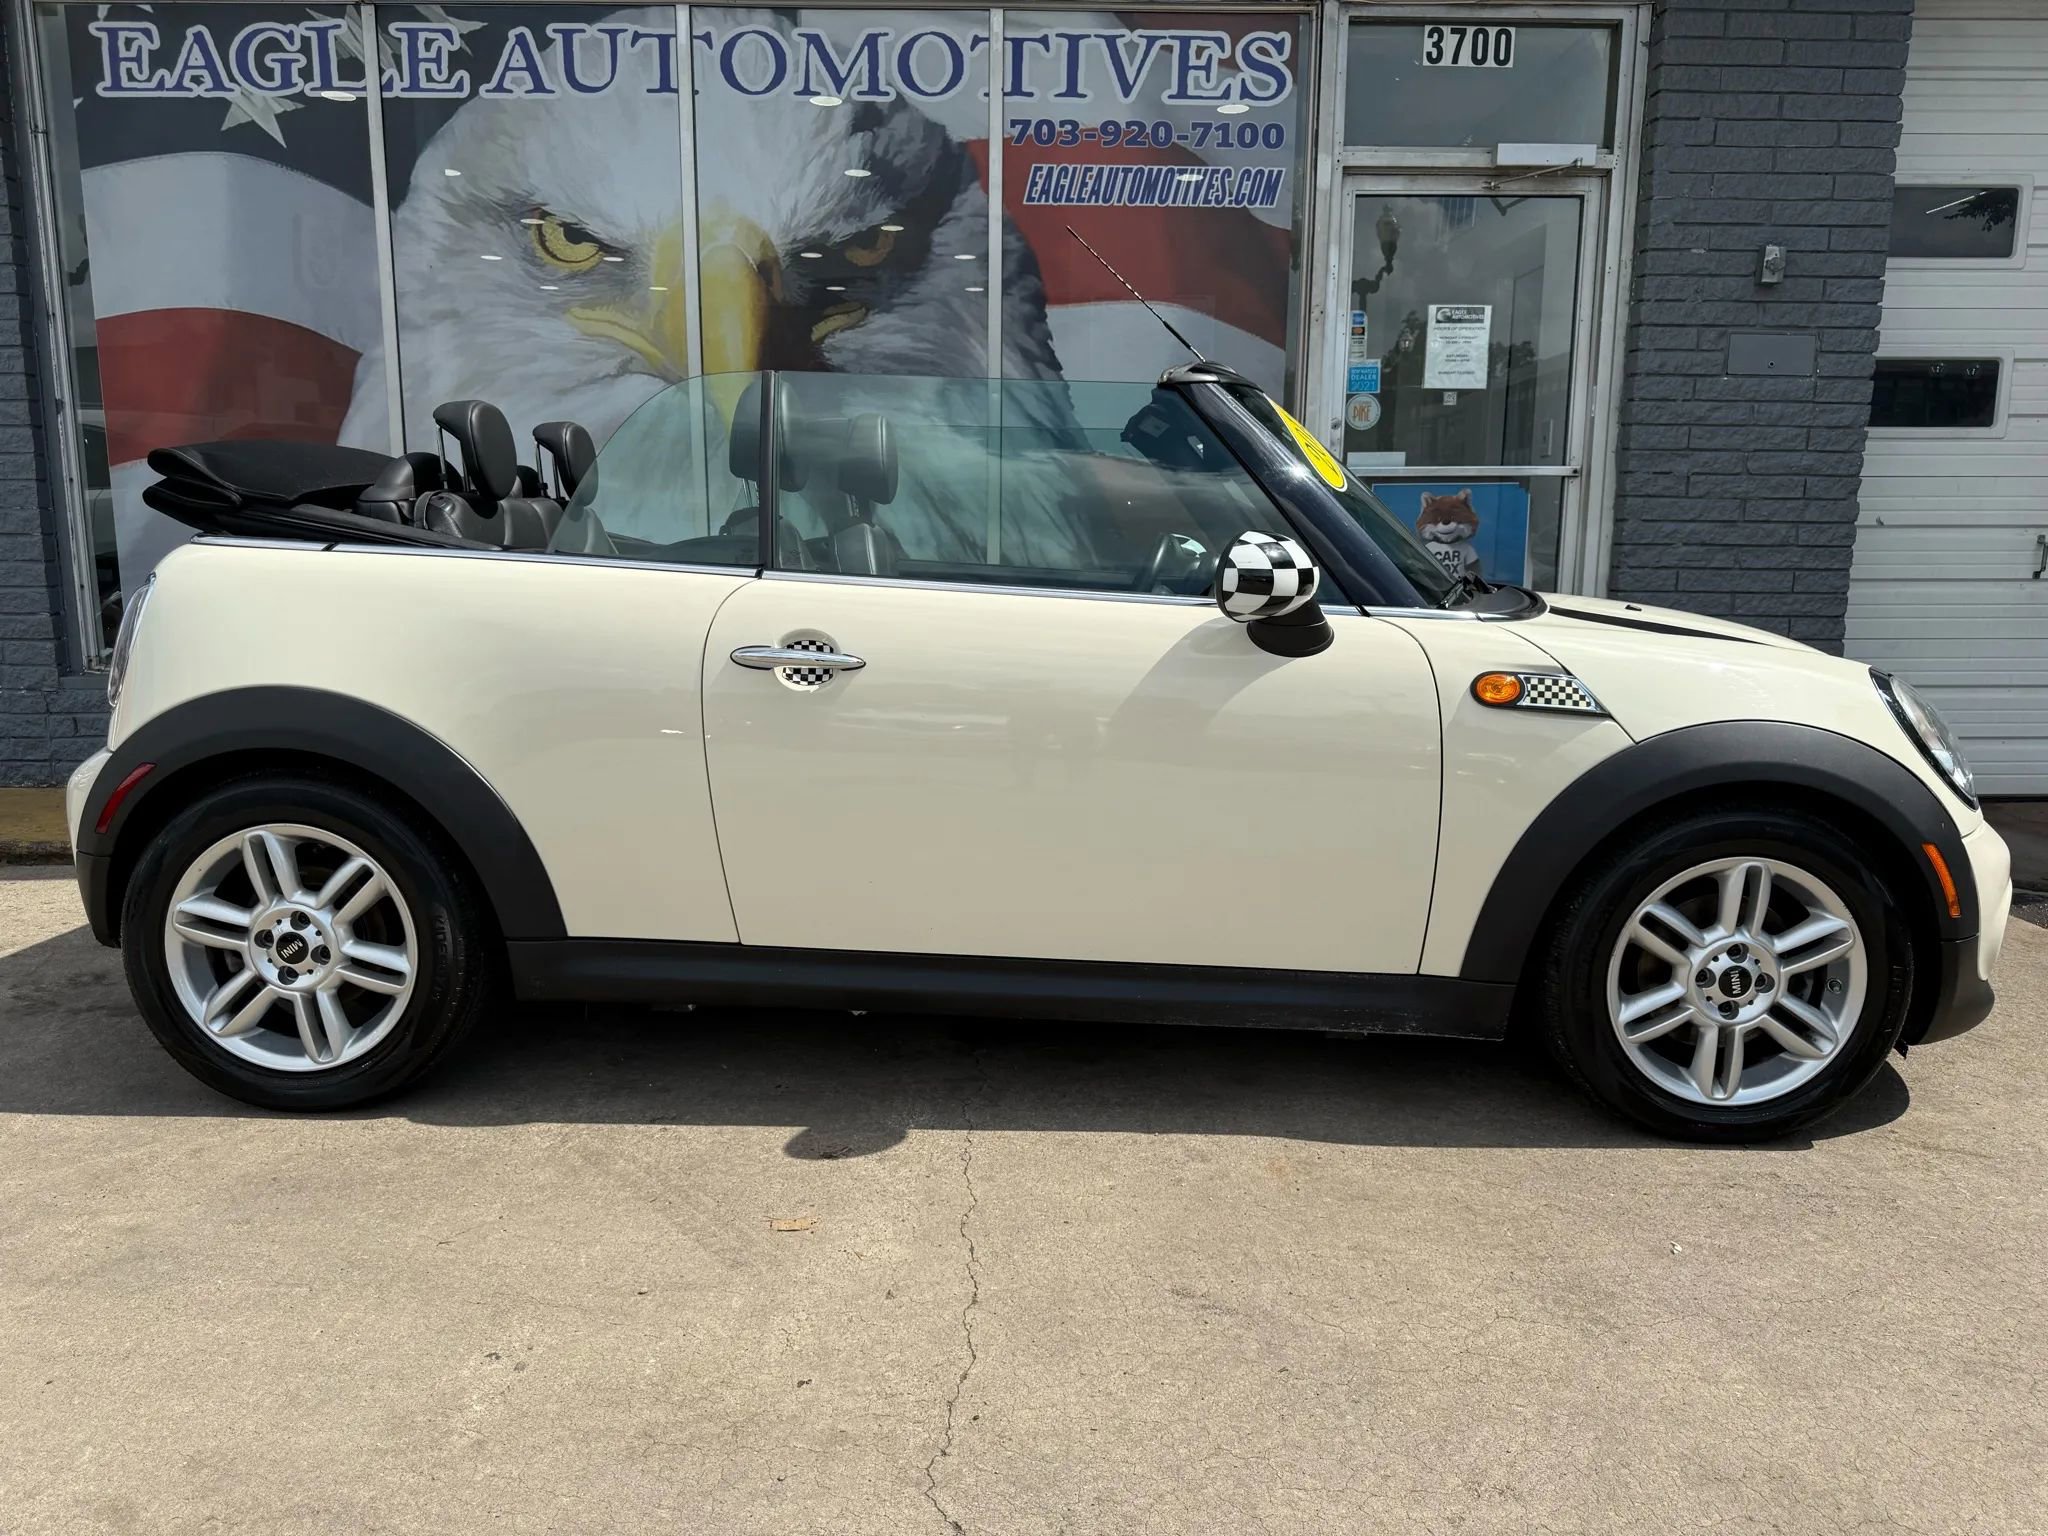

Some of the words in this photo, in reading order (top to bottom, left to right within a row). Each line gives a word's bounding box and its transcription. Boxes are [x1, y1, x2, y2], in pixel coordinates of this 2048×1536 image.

[1426, 26, 1512, 67] 3700
[90, 22, 471, 98] EAGLE
[481, 22, 1292, 106] AUTOMOTIVES
[1009, 118, 1285, 149] 703-920-7100
[1023, 164, 1286, 208] EAGLEAUTOMOTIVES.COM
[1434, 550, 1461, 562] CAR
[1443, 562, 1460, 574] OX
[280, 938, 304, 959] MINI
[1729, 970, 1742, 995] MINI
